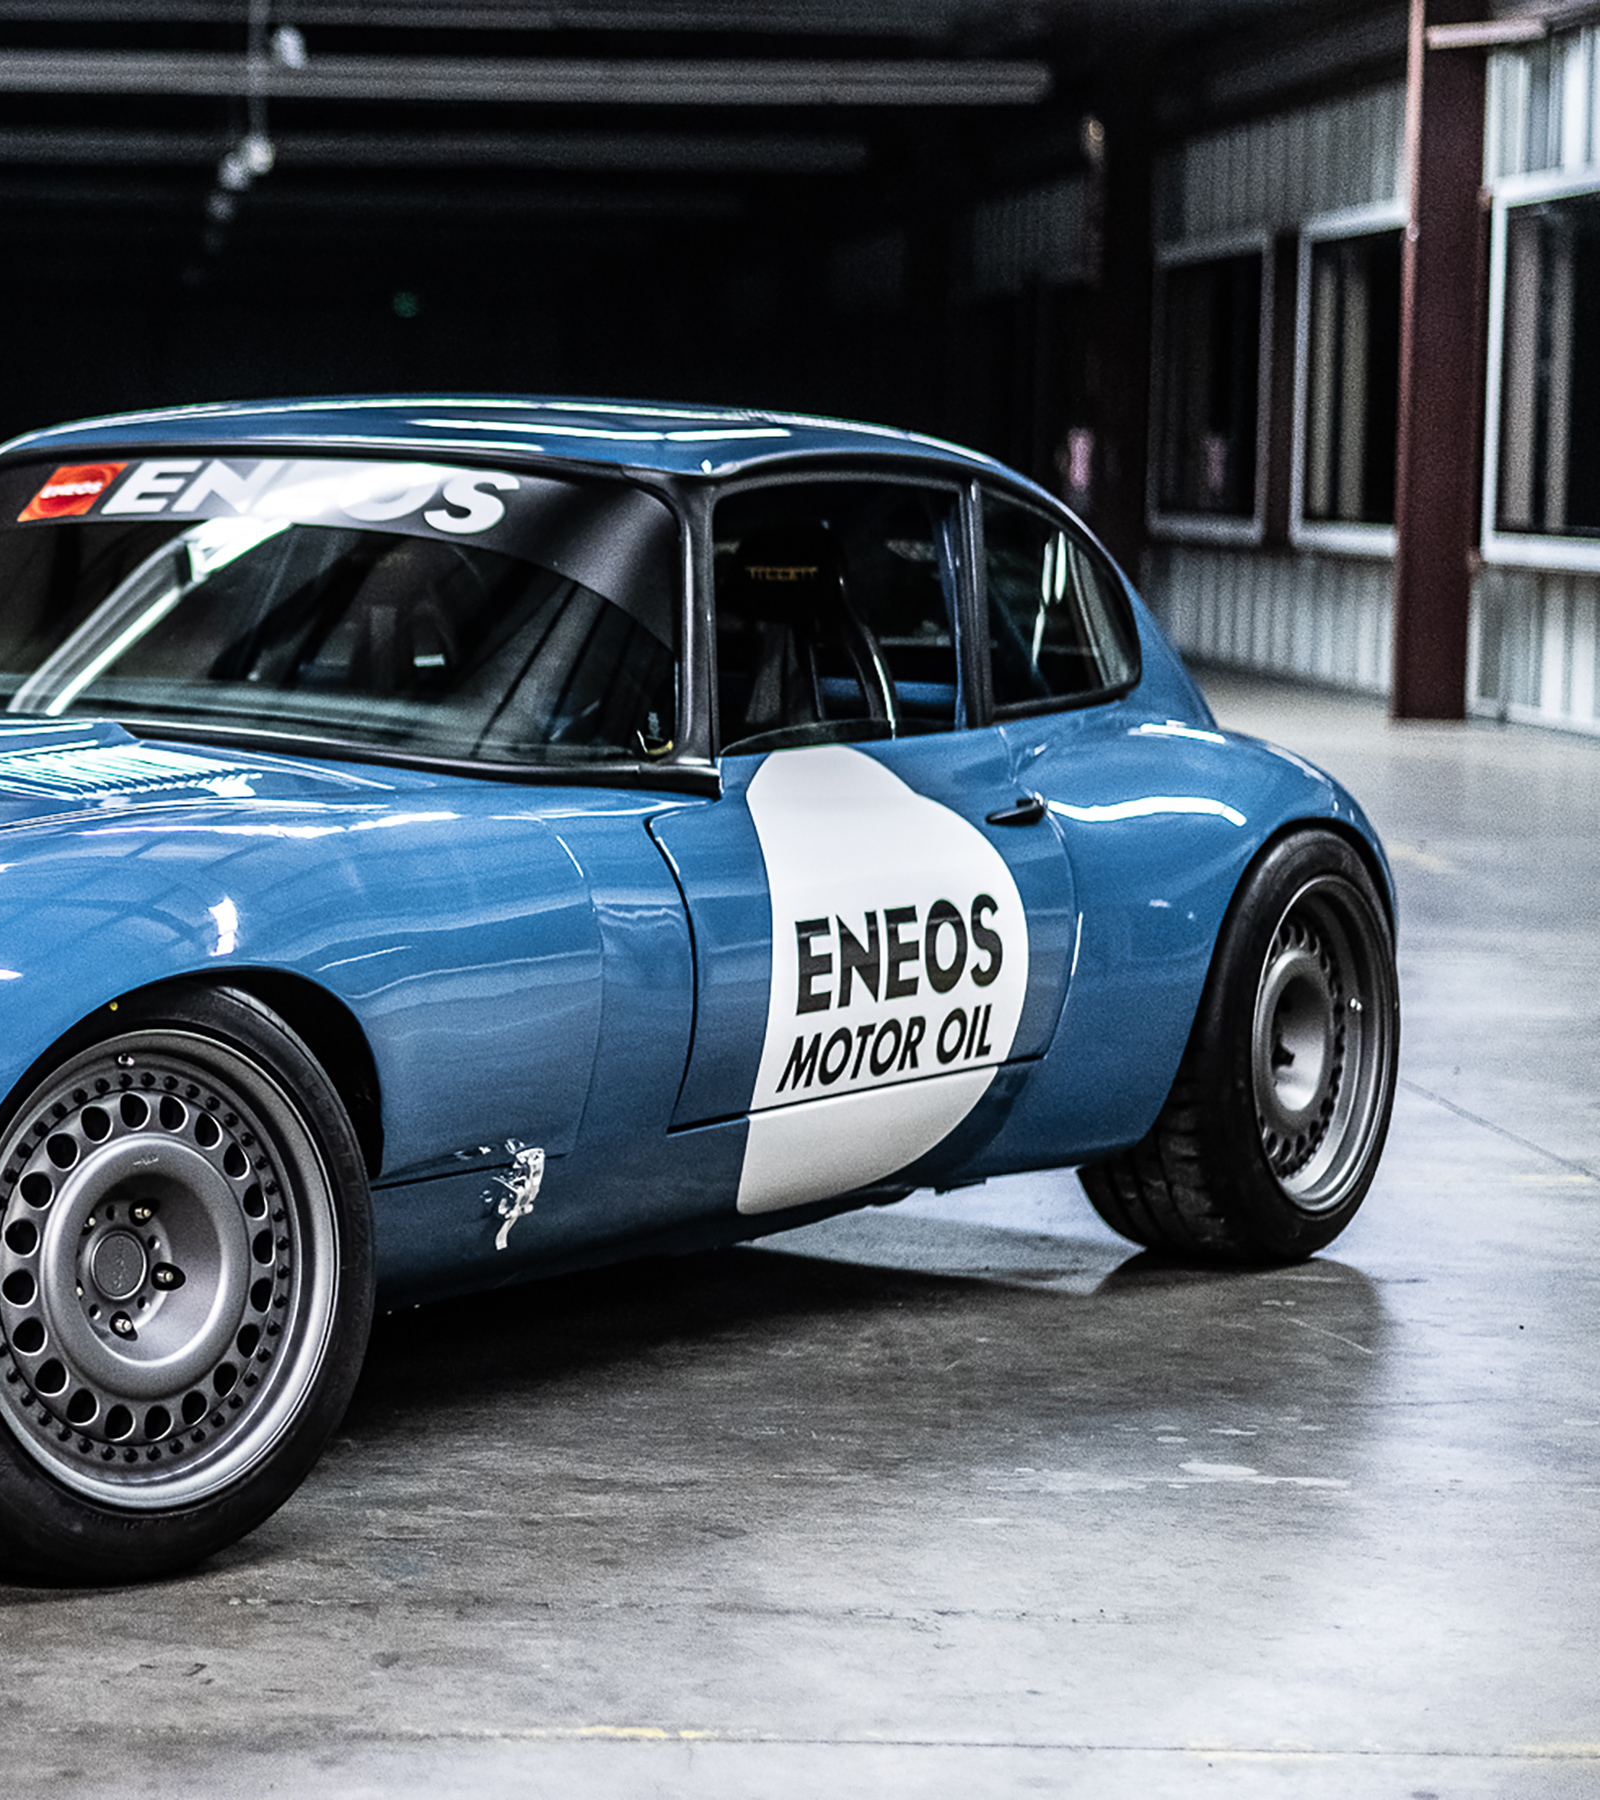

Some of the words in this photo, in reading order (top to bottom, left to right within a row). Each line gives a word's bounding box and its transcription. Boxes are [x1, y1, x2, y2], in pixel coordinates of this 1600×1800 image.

[794, 894, 1003, 1015] ENEOS
[775, 1016, 926, 1093] MOTOR
[936, 1004, 992, 1065] OIL
